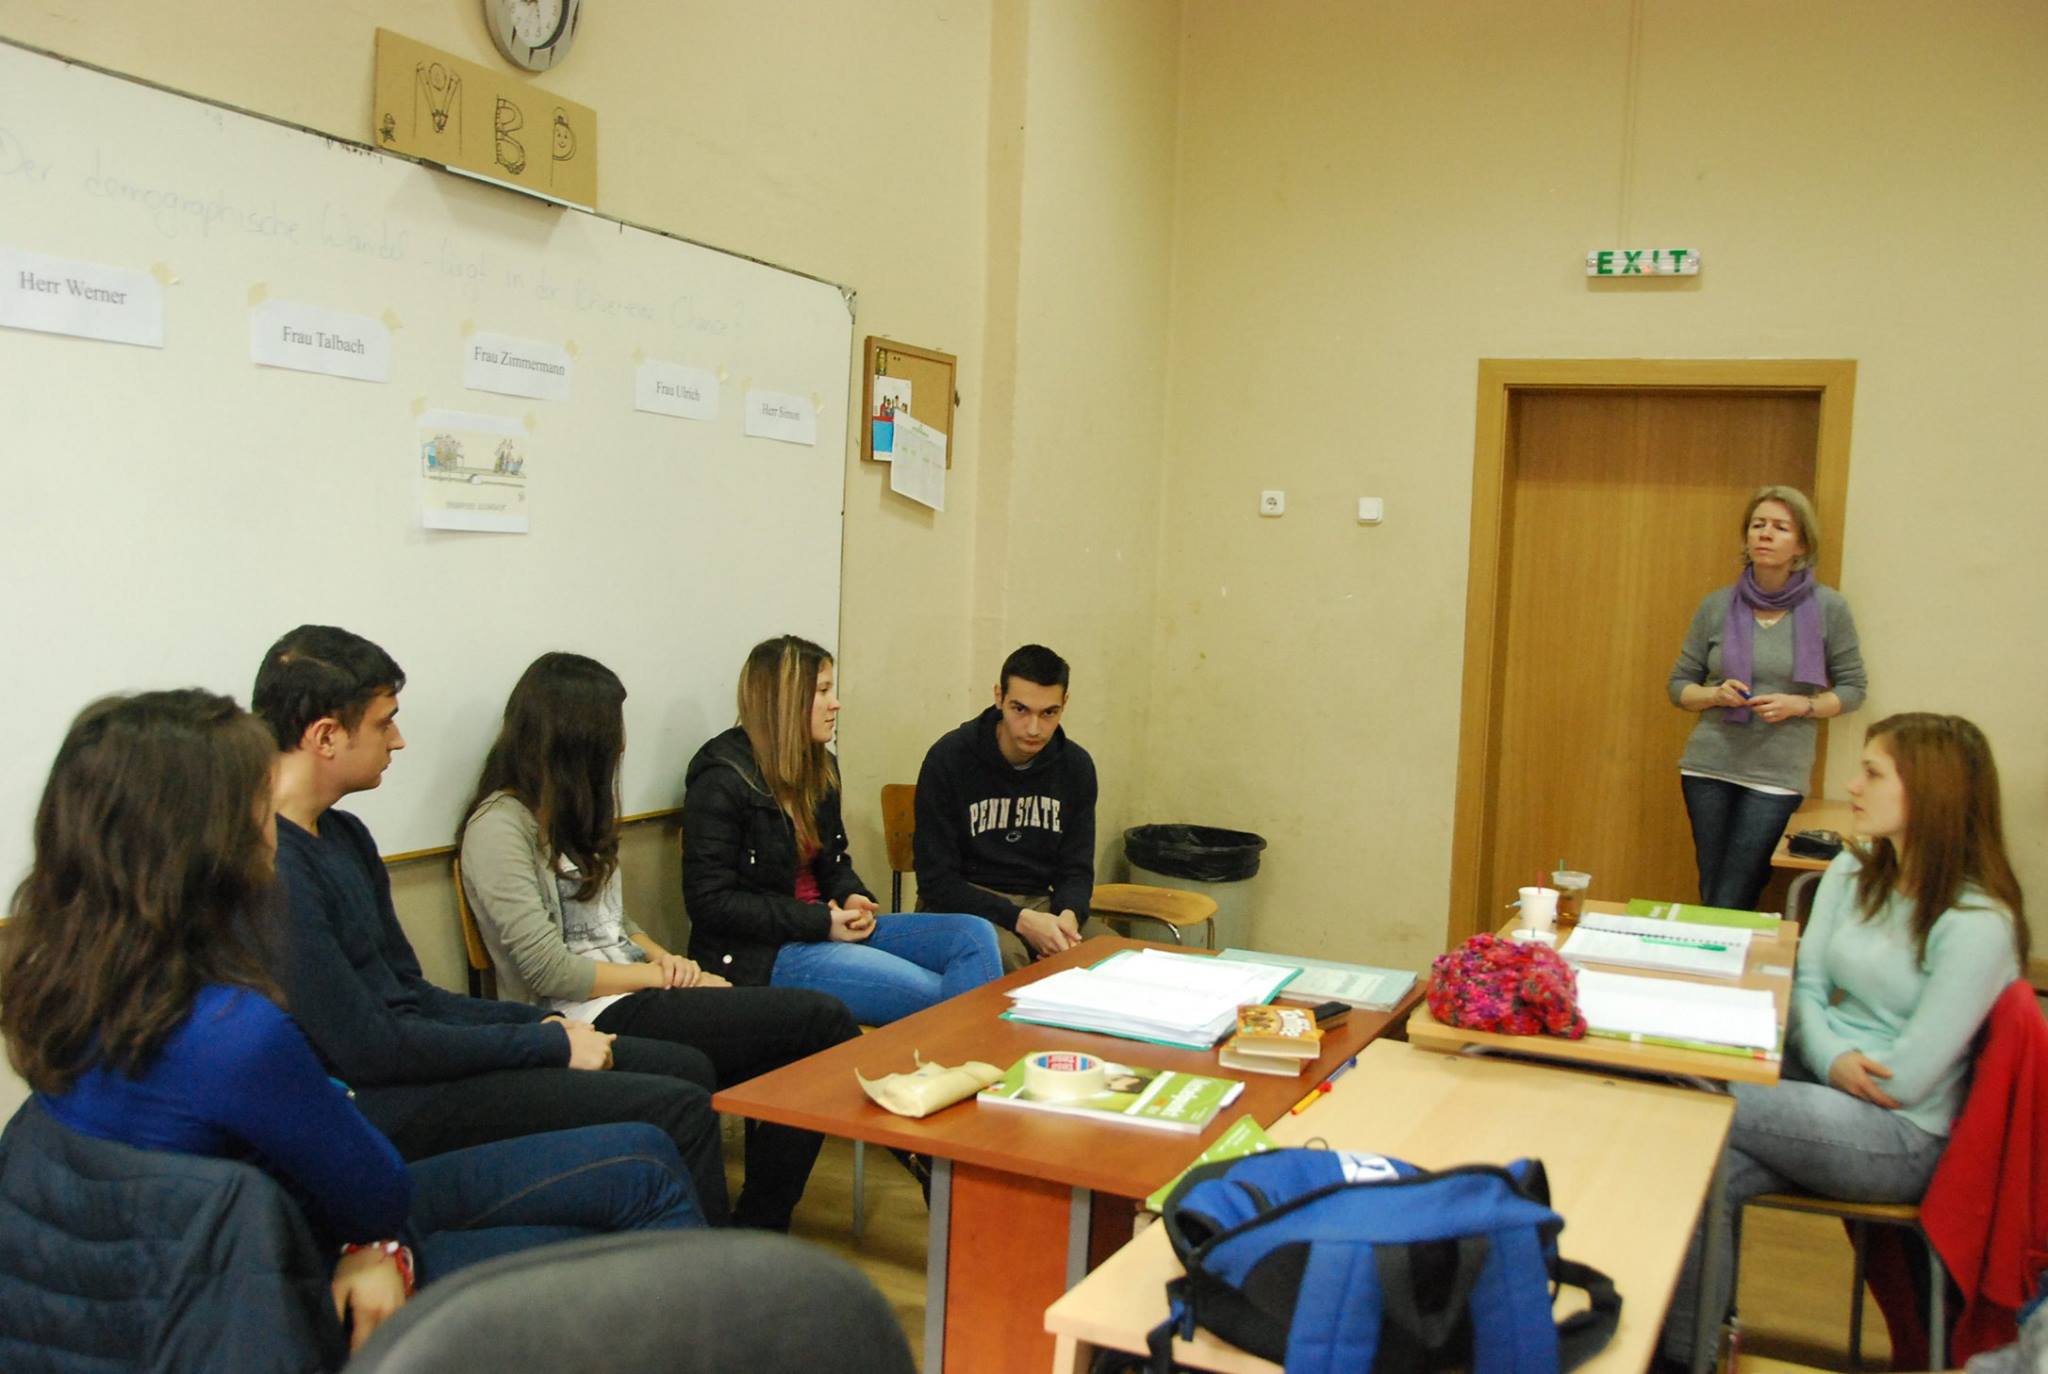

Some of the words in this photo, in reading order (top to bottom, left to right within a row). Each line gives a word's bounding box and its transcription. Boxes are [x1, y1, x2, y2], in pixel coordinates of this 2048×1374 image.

[1597, 249, 1688, 275] EXIT
[20, 271, 61, 294] Herr
[65, 278, 128, 305] Werner
[283, 325, 313, 346] Frau
[316, 331, 365, 355] Talbach
[474, 345, 499, 364] Frau
[500, 350, 566, 377] Zimmermann
[656, 381, 675, 397] Frau
[969, 798, 1011, 837] PENN
[1015, 795, 1061, 833] STATE
